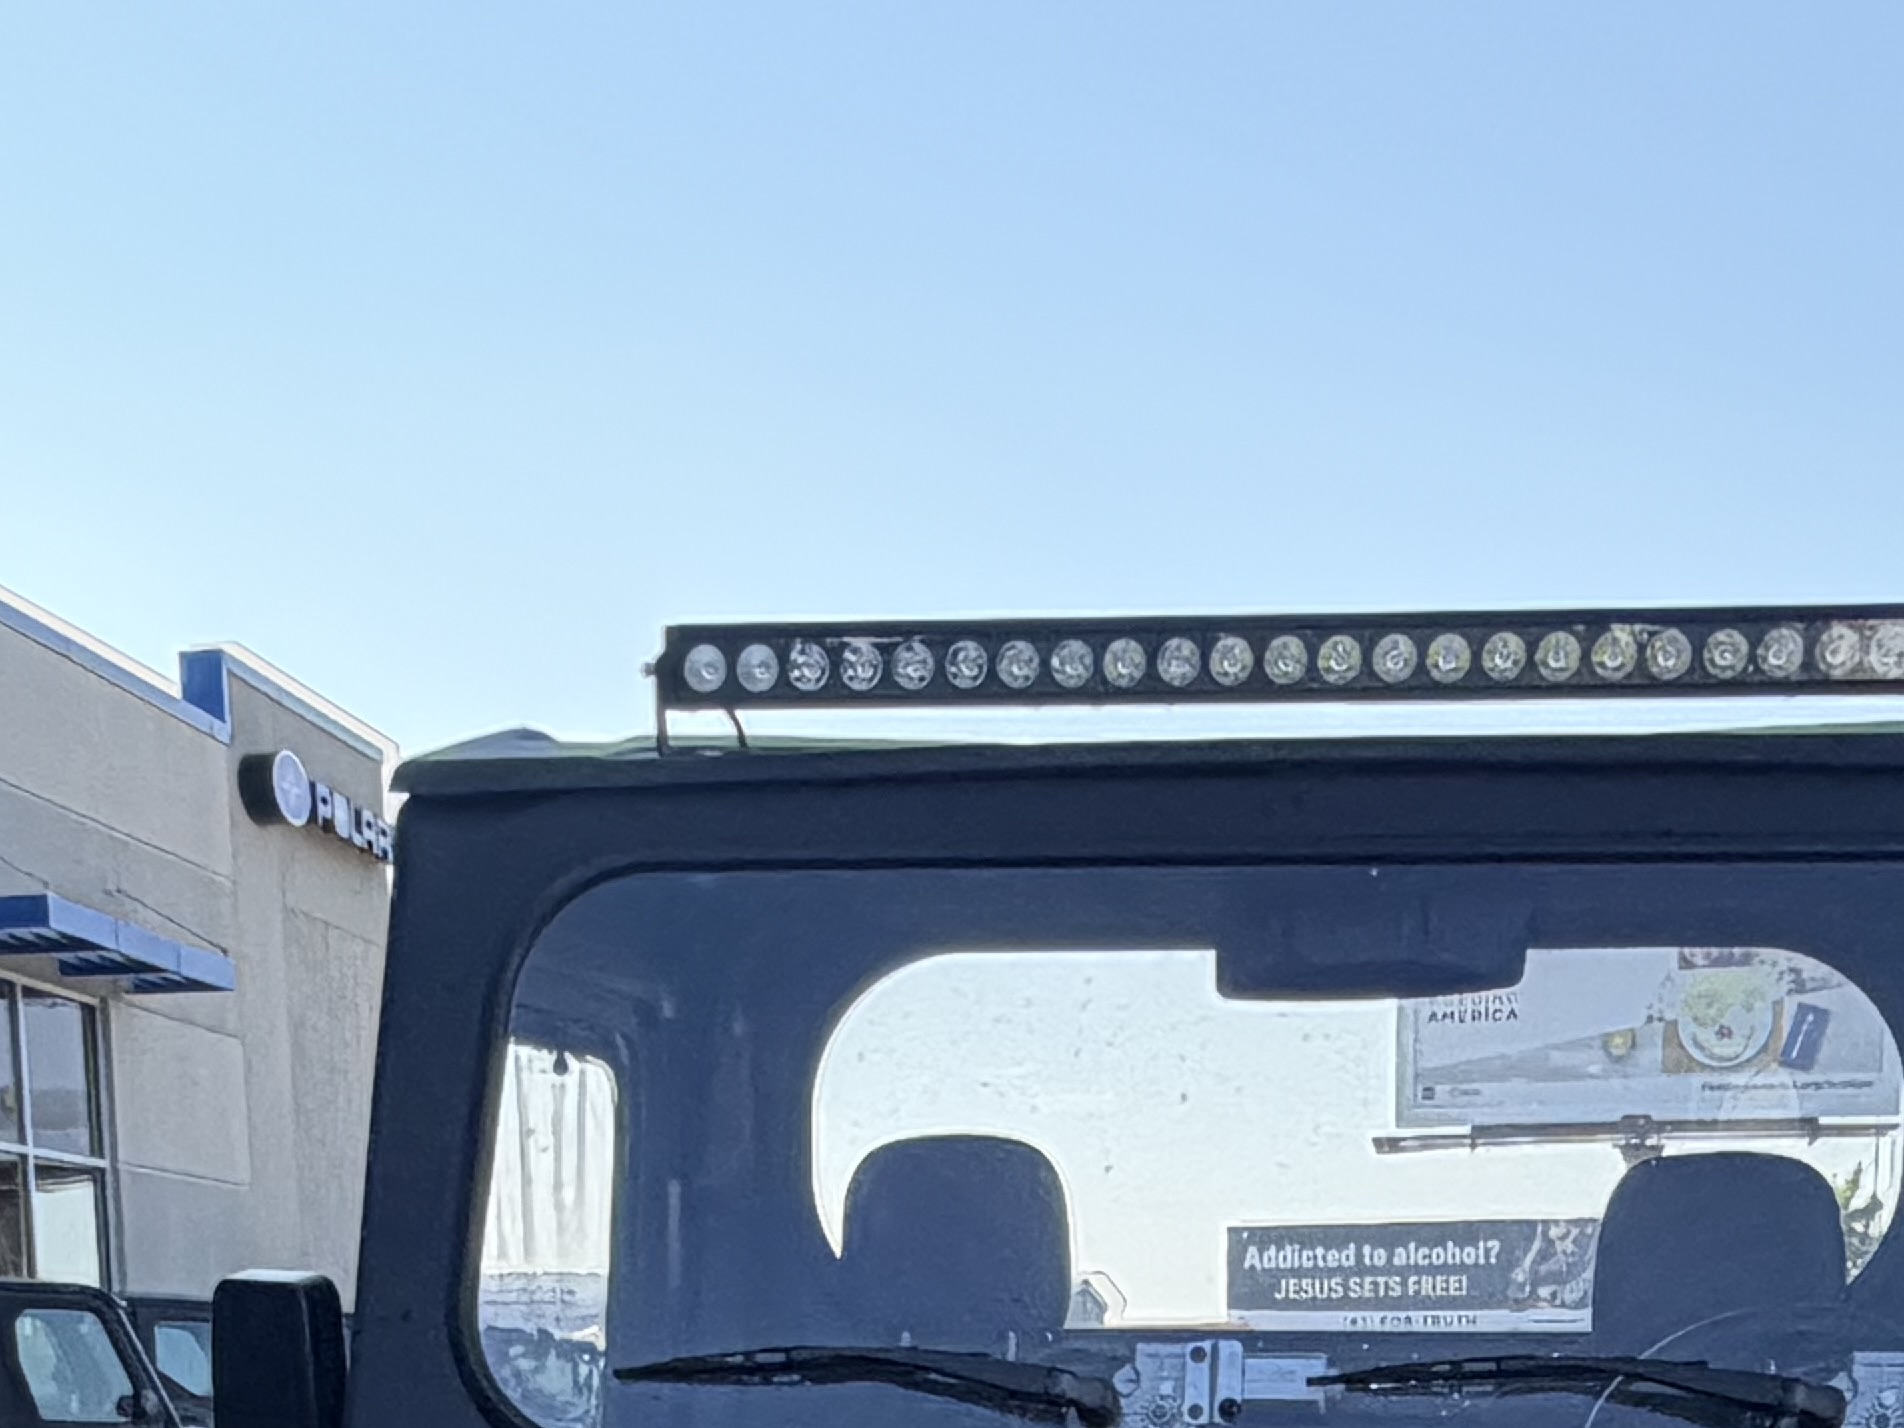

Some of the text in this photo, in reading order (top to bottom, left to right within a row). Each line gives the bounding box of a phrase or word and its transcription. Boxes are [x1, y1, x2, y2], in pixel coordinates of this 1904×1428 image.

[1427, 1007, 1518, 1023] AMERICA
[1244, 1240, 1501, 1270] Addicted to alcohol?
[1275, 1275, 1468, 1300] JESUS SETS FREE!
